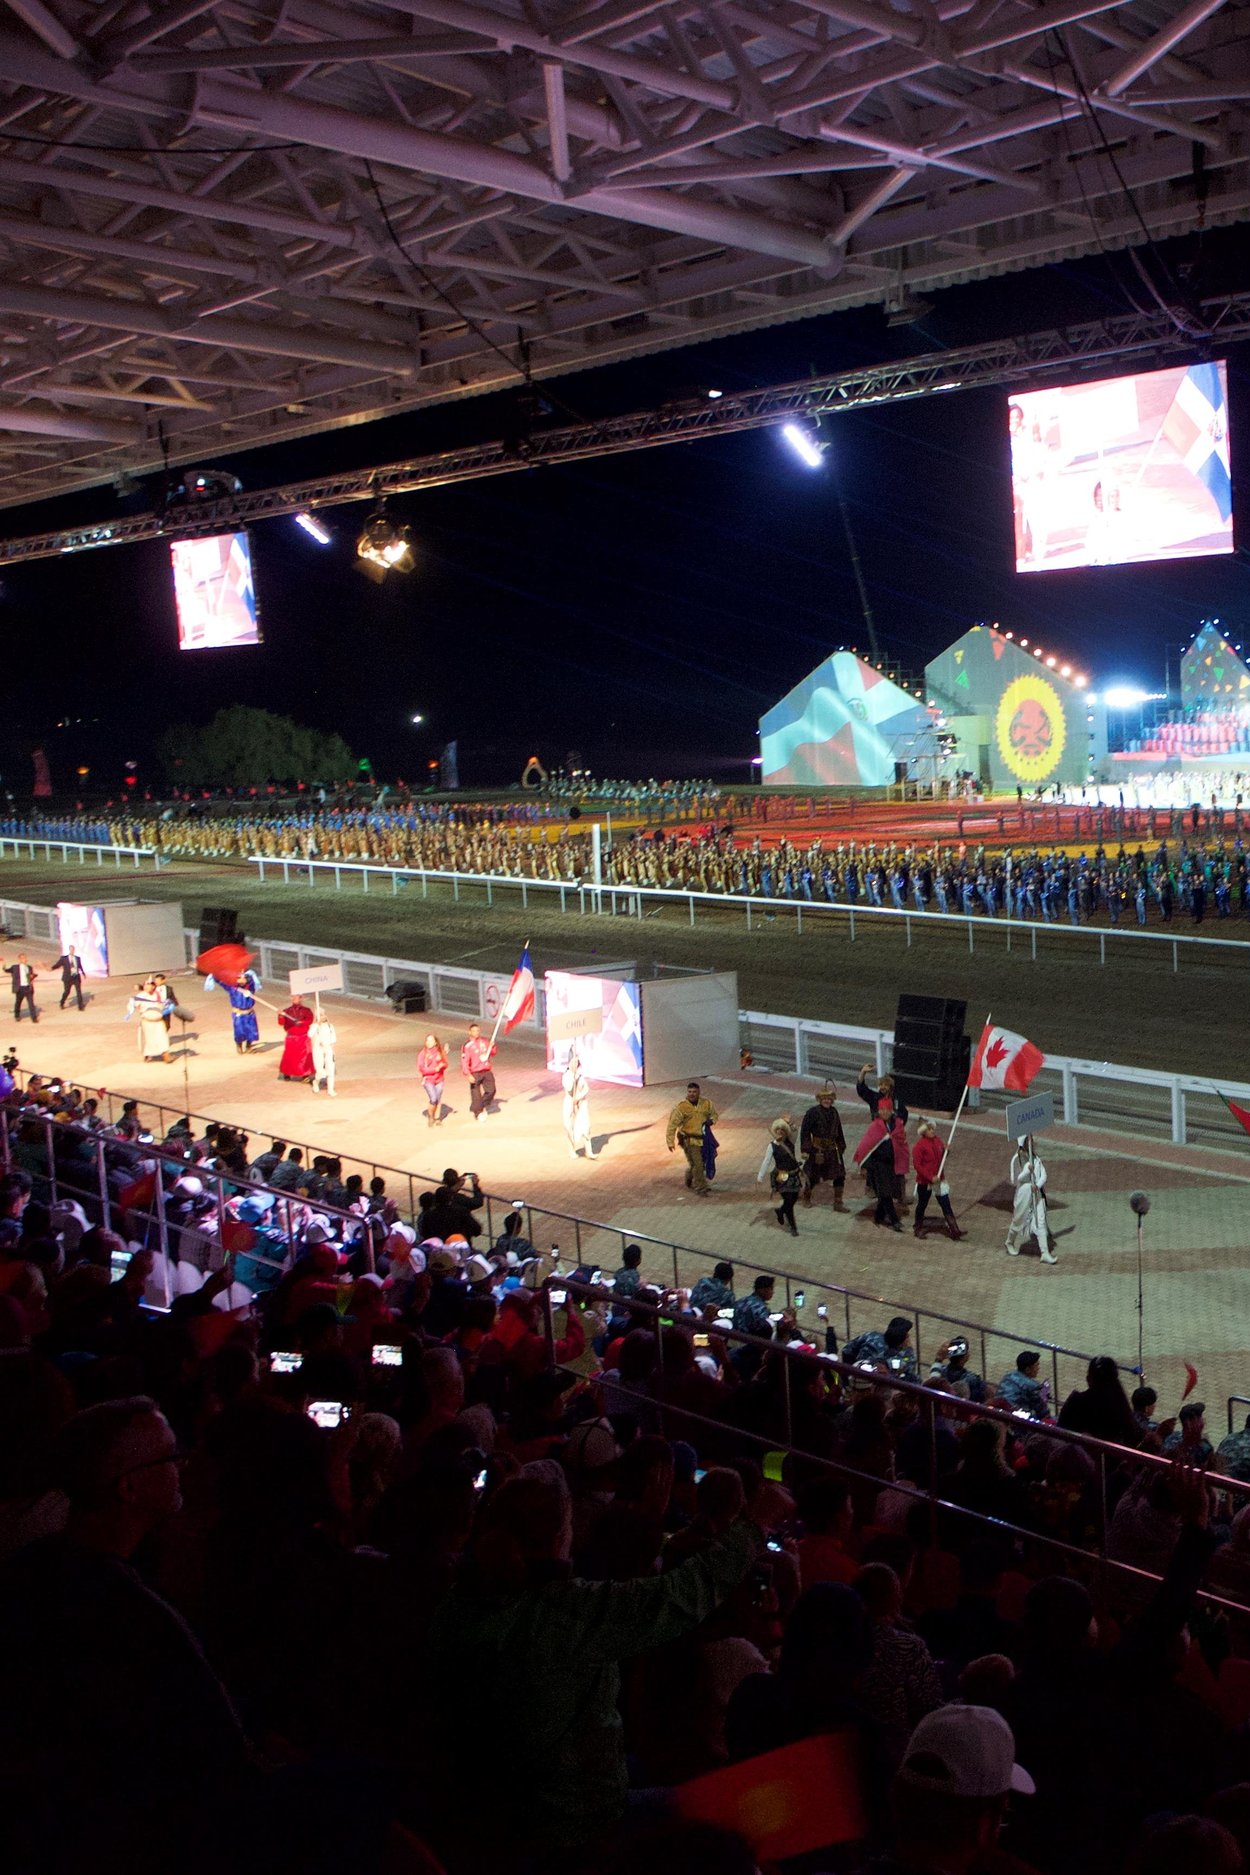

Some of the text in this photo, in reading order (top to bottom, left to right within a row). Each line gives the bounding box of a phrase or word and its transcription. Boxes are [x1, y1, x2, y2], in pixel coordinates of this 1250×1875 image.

[305, 975, 329, 985] CHINA
[565, 1018, 586, 1030] CHILE
[1016, 1106, 1045, 1125] CANADA
